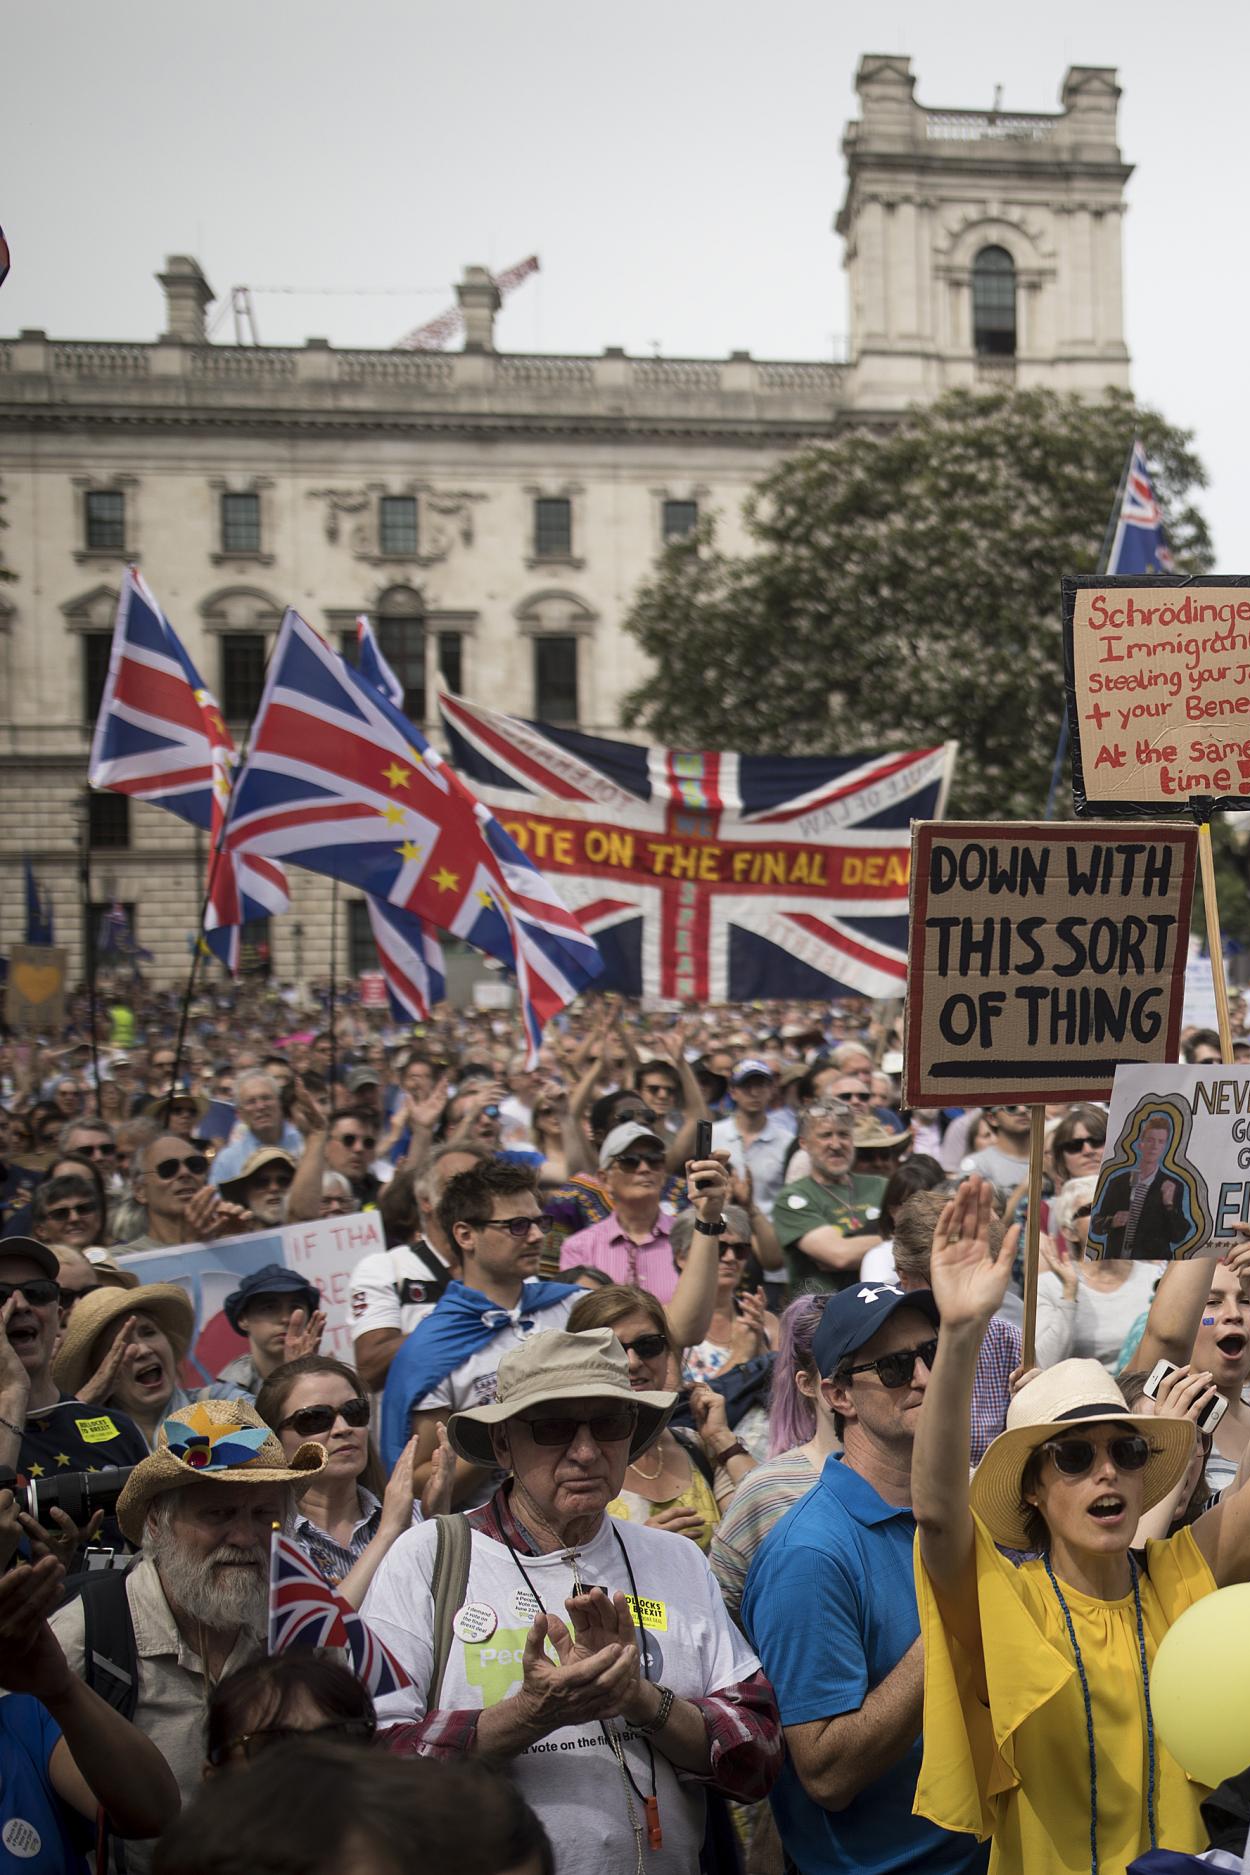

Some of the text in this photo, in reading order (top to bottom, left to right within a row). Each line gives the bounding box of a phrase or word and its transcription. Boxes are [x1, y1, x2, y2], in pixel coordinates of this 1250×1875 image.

[1188, 666, 1231, 692] your
[1085, 702, 1110, 729] +
[1118, 702, 1173, 729] your
[1094, 743, 1126, 769] At
[1136, 739, 1178, 765] the
[503, 821, 911, 886] OTE ON THE FINAL DEA
[930, 843, 1172, 897] DOWN WITH
[926, 915, 1177, 977] THIS SORT
[939, 991, 1006, 1049] OF
[1015, 986, 1163, 1046] THING
[292, 1232, 318, 1262] IF
[469, 1612, 481, 1620] vote
[470, 1607, 492, 1618] demand
[531, 1742, 557, 1753] vote
[560, 1741, 575, 1750] on
[578, 1737, 597, 1748] the
